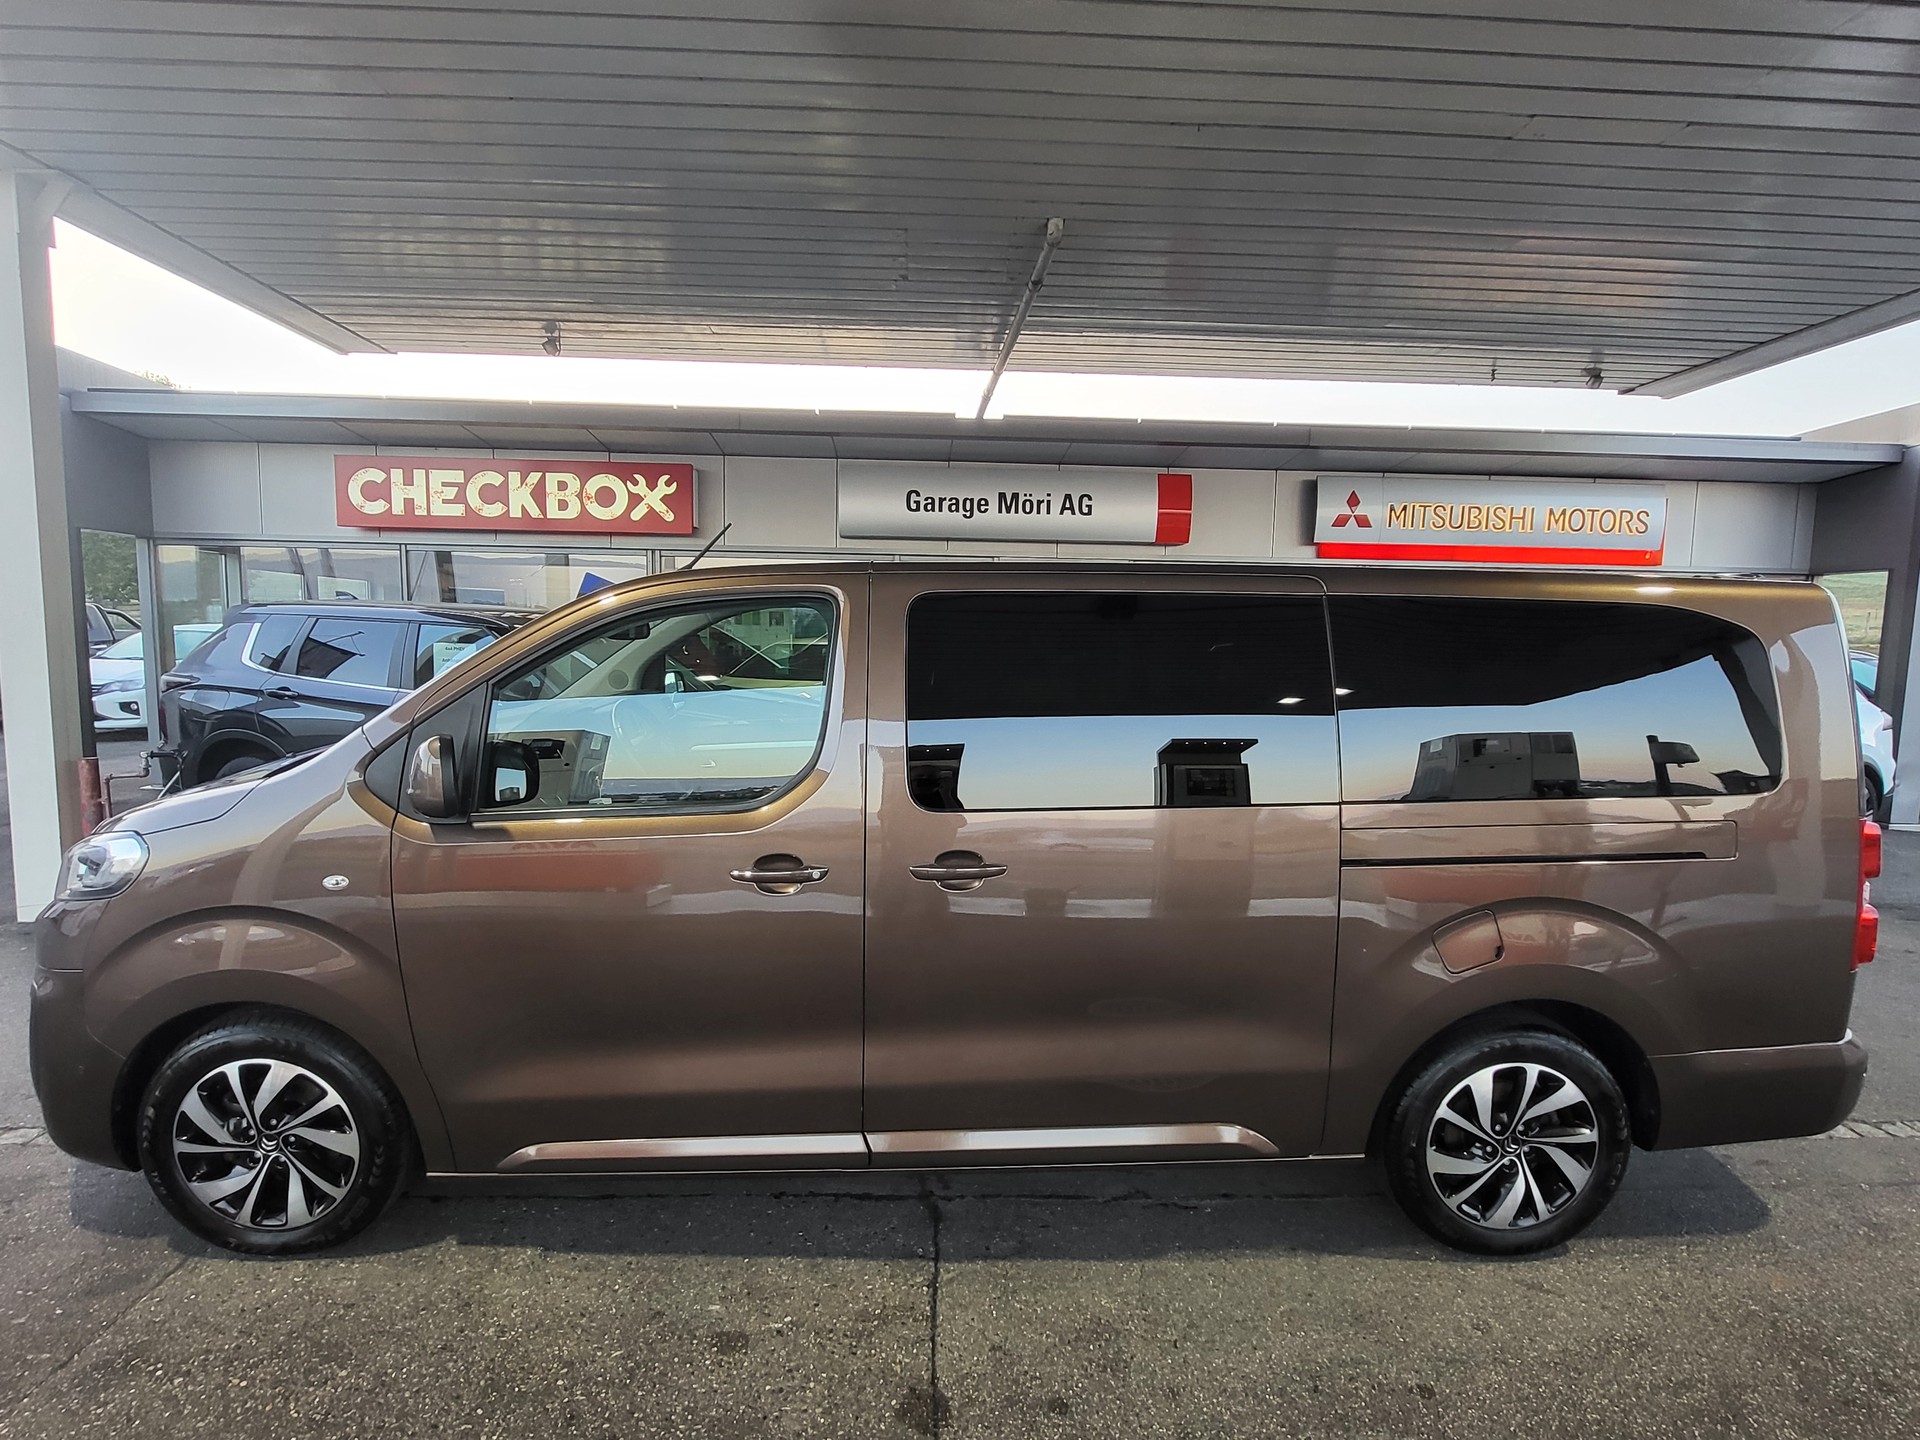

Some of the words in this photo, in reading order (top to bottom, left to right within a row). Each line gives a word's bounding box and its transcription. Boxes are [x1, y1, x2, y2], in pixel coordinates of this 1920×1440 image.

[347, 467, 677, 522] CHECKBOX
[905, 489, 990, 518] Garage
[997, 491, 1052, 515] Möri
[1059, 493, 1093, 516] AG
[1385, 502, 1536, 533] MITSUBISHI
[1544, 507, 1651, 536] MOTORS
